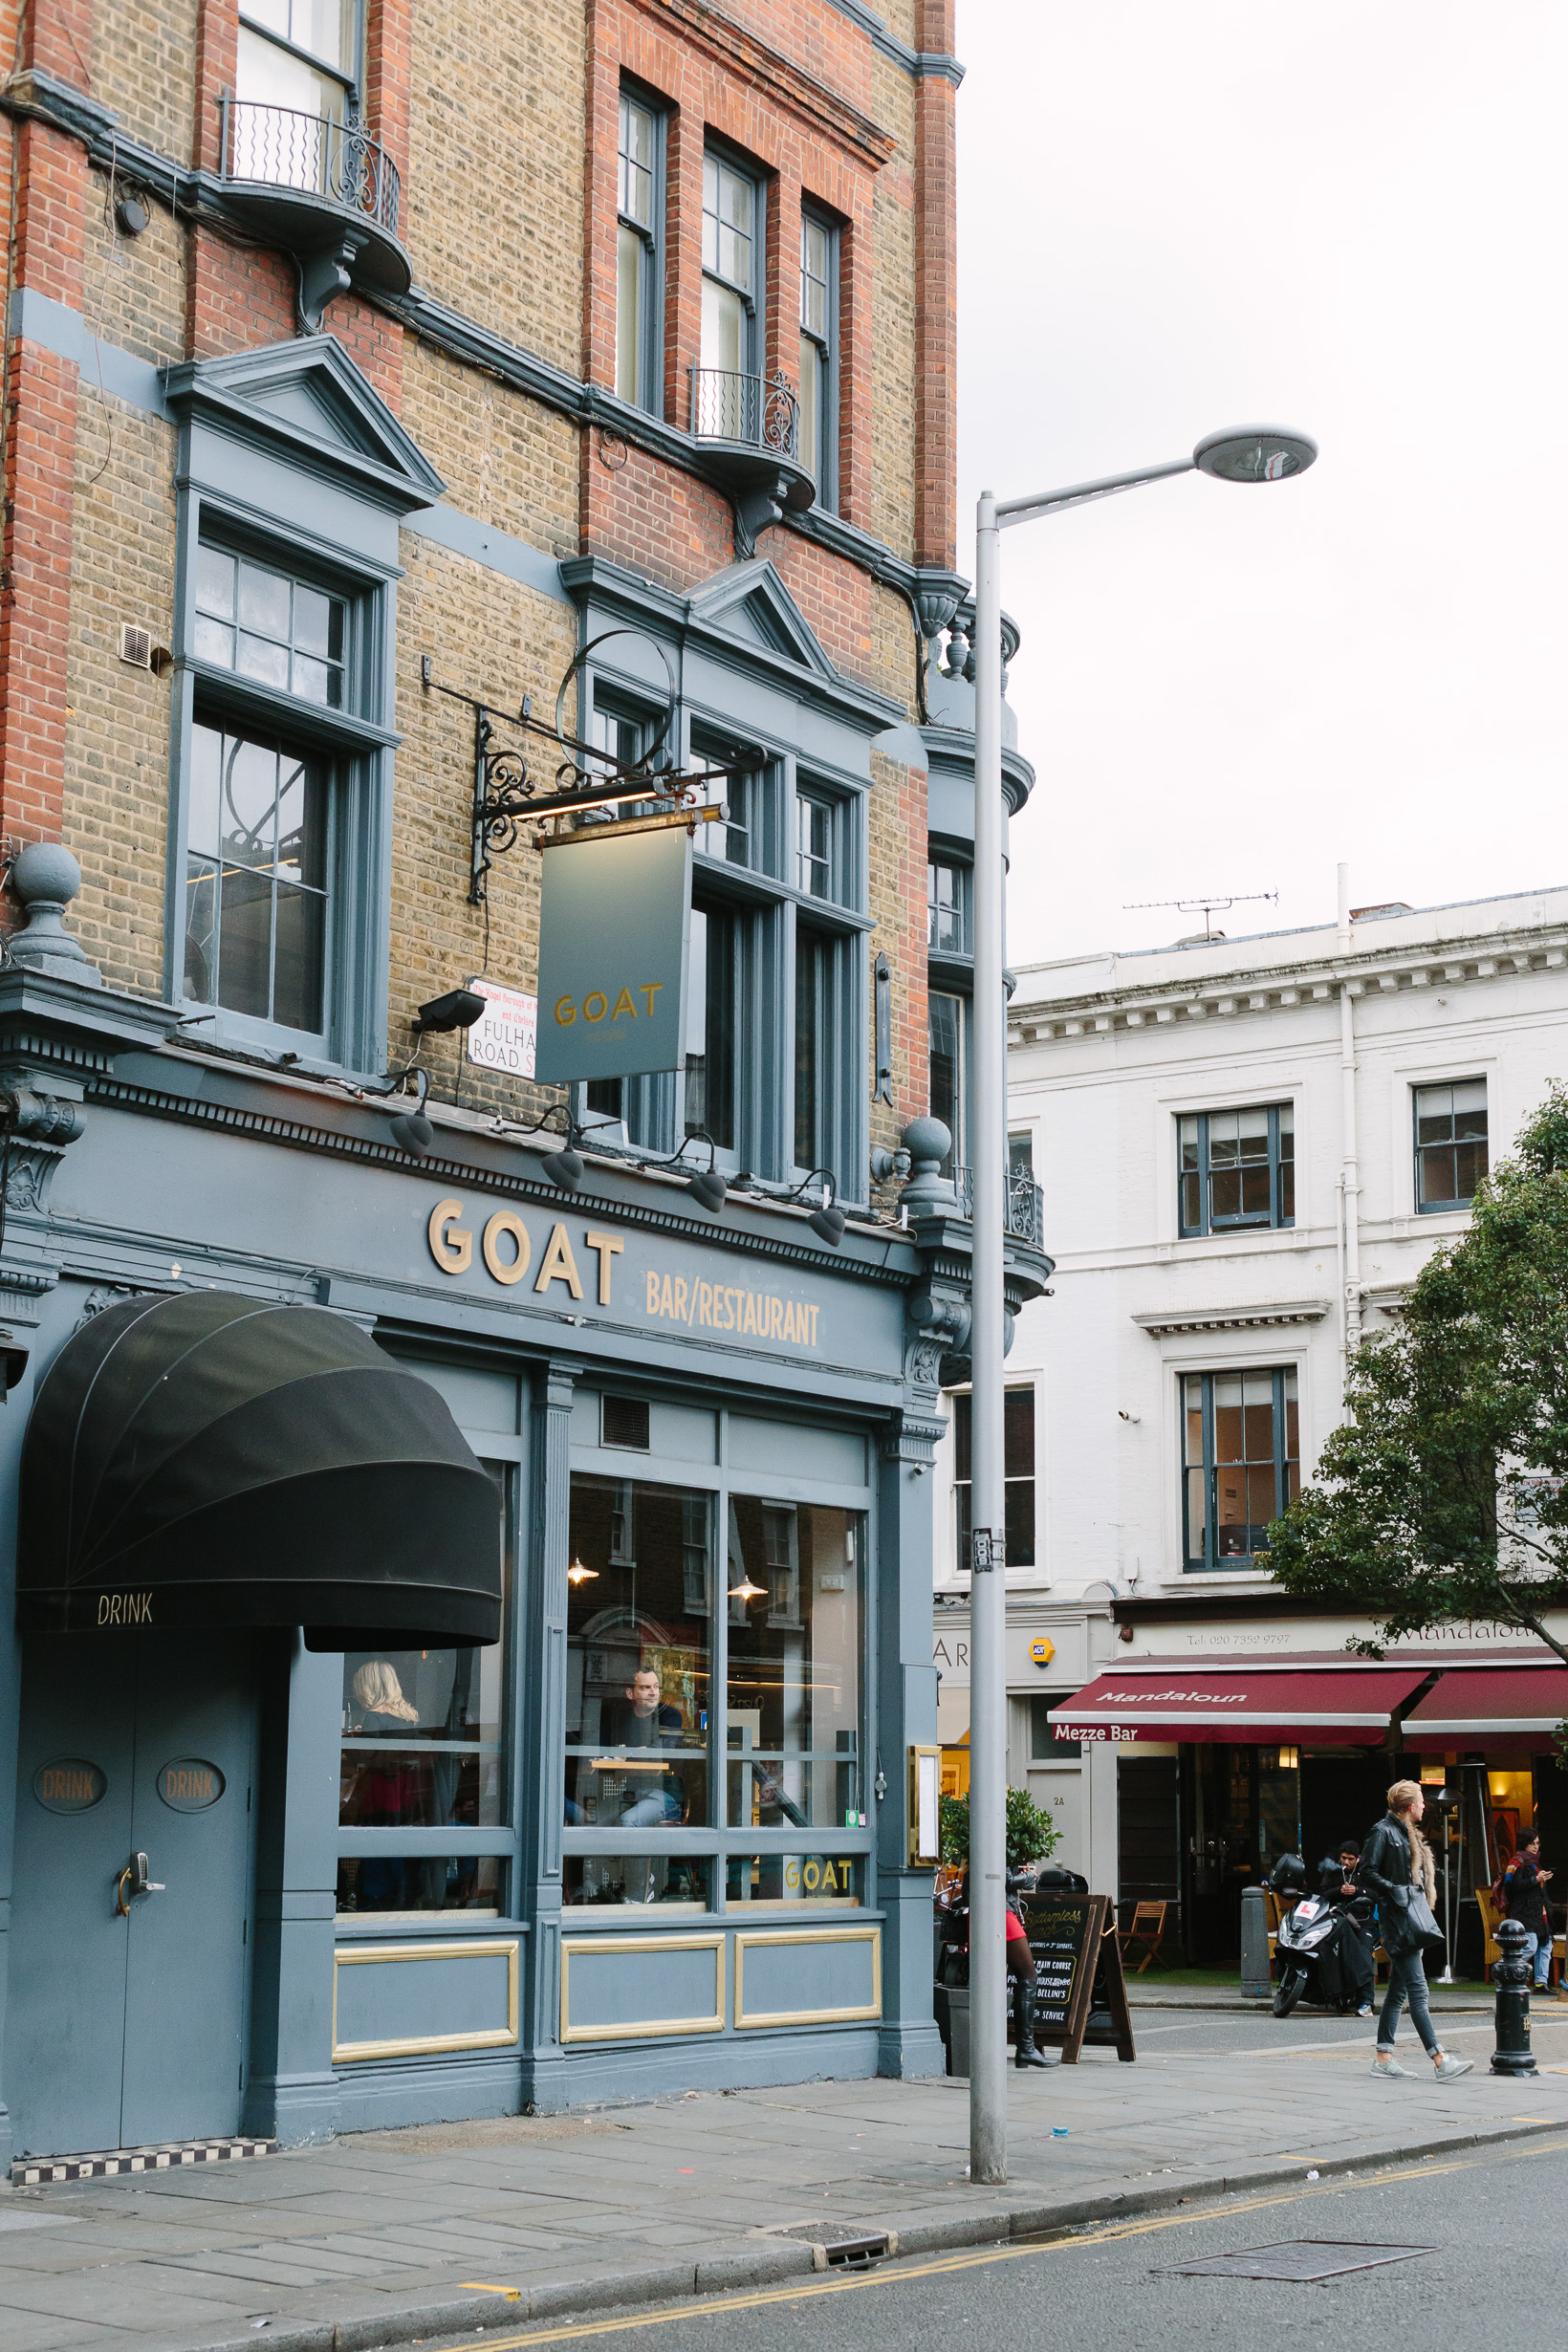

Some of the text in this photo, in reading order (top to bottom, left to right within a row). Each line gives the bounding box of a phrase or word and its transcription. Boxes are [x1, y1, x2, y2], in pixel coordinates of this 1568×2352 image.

[485, 988, 502, 1003] Royal
[502, 993, 525, 1010] Borough
[555, 982, 663, 1027] GOAT
[502, 1012, 534, 1028] and Chelsea
[484, 1019, 536, 1052] FULHA
[428, 1198, 820, 1347] GOAT BAR/RESTAURANT
[98, 1593, 153, 1625] DRINK
[1209, 1635, 1230, 1644] 020
[1233, 1635, 1260, 1644] 7352
[1263, 1634, 1291, 1644] 9797
[1034, 1645, 1044, 1654] ADT
[1096, 1690, 1248, 1703] Mandaloun
[1055, 1724, 1138, 1741] Mezze Bar
[43, 1770, 94, 1800] DRINK
[166, 1770, 213, 1799] DRINK
[1054, 1797, 1064, 1806] 2A
[785, 1860, 853, 1890] GOAT
[1036, 1960, 1072, 1971] MAIN COURSE
[1042, 2011, 1065, 2020] SERVICE
